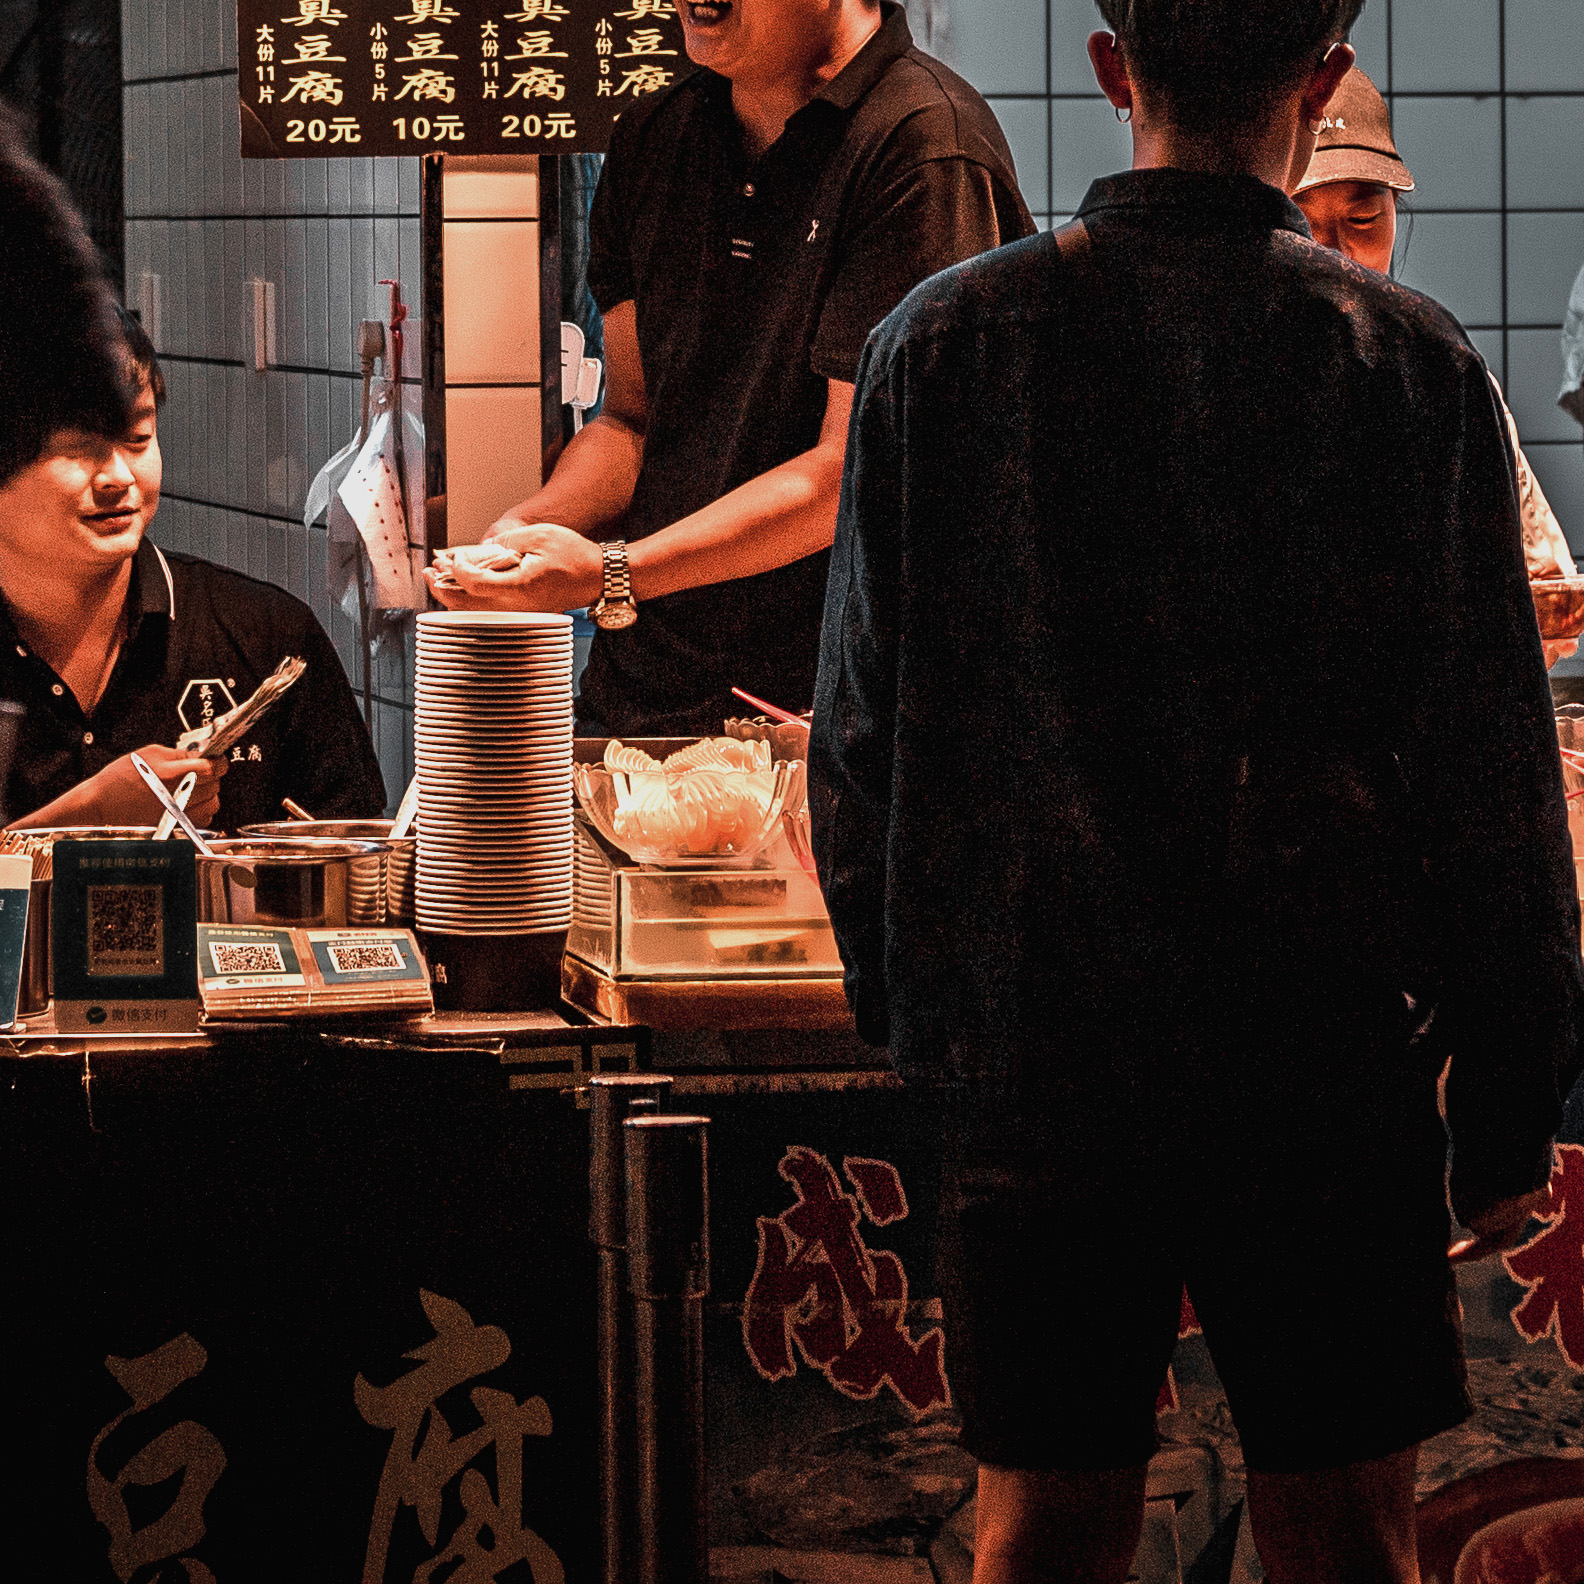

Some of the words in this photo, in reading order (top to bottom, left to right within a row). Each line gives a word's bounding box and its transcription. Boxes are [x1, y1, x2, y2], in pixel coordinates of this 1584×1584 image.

[286, 117, 362, 145] 20元
[392, 115, 466, 143] 10元
[501, 112, 578, 140] 20元
